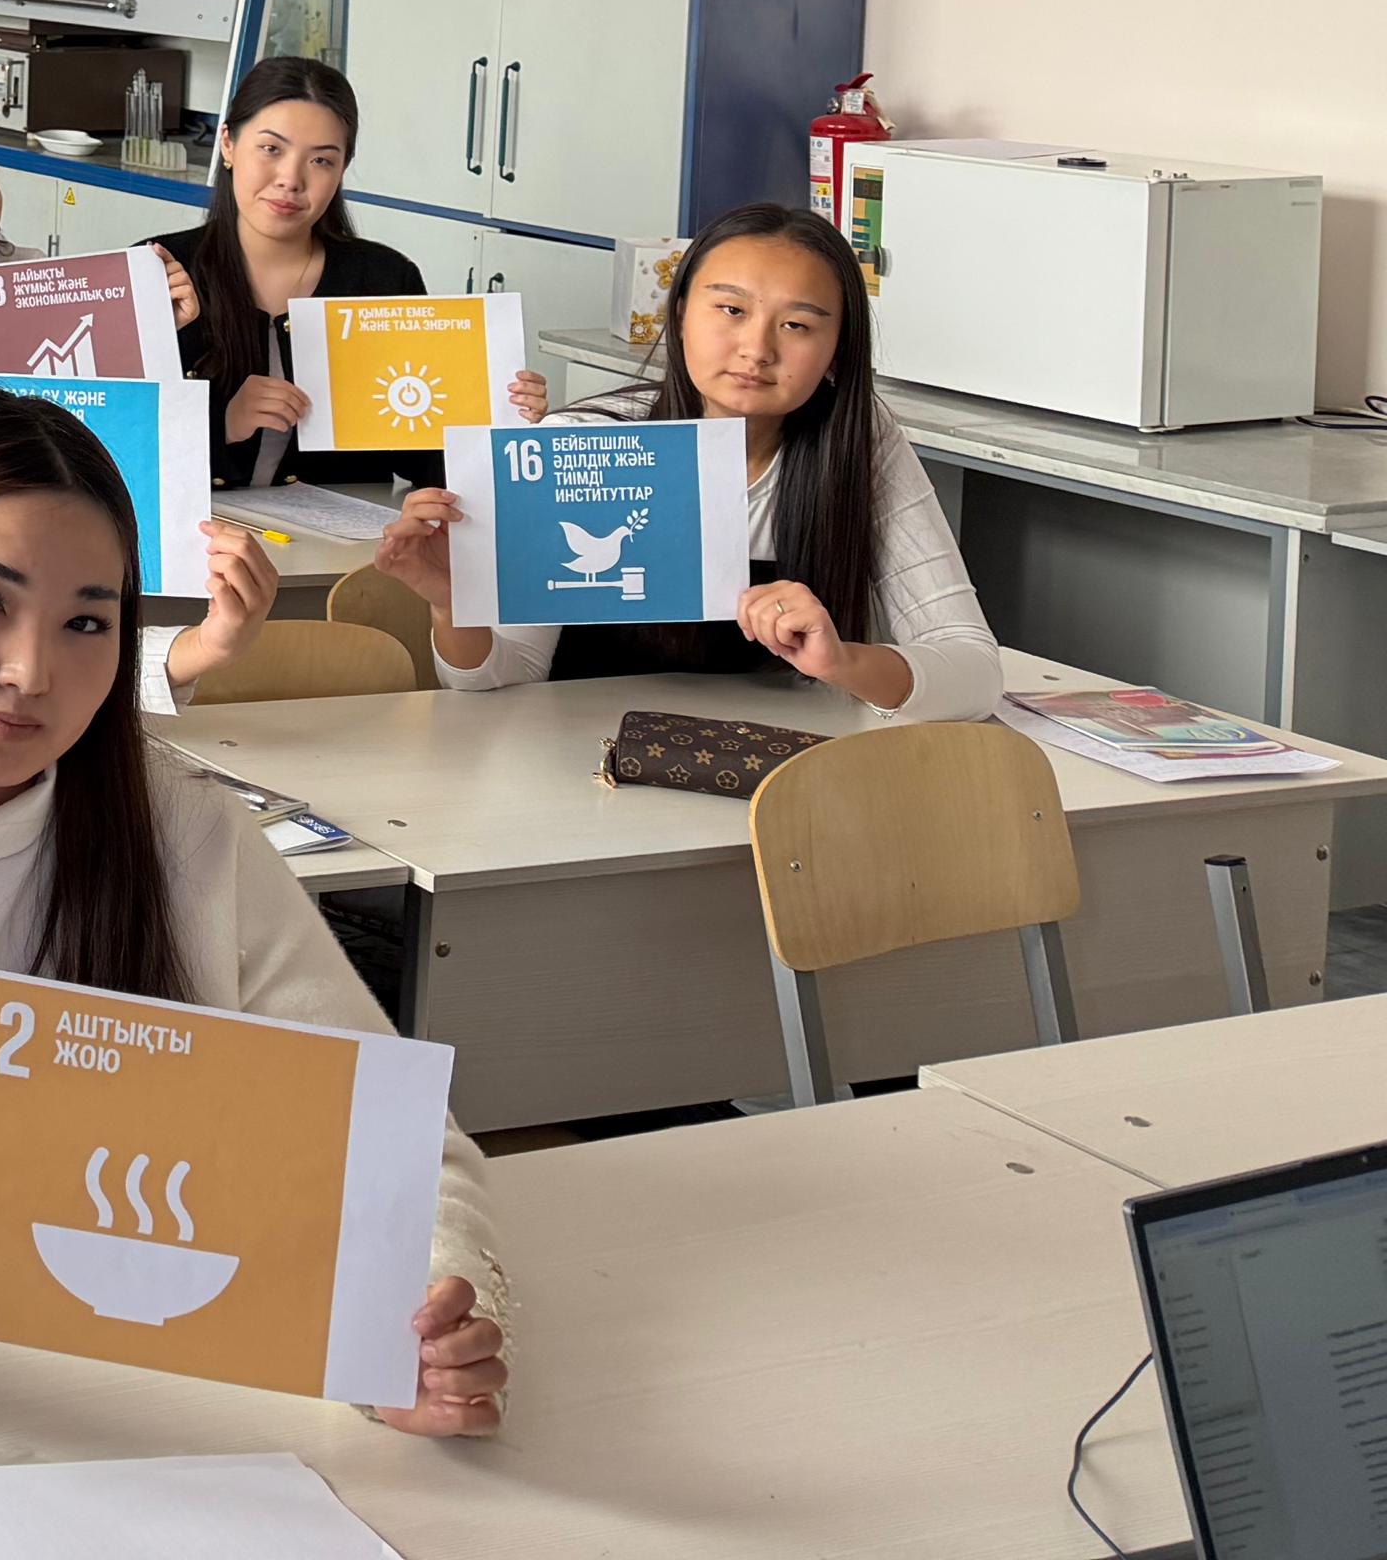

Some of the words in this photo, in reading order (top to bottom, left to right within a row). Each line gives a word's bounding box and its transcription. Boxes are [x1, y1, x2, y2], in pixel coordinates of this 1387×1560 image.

[12, 267, 65, 283] ЛАЙЫҚТЫ
[13, 282, 56, 296] ЖҰМЫС
[57, 277, 89, 291] ЖӘНЕ
[14, 290, 105, 309] ЭКОНОМИКАЛЫҚ
[105, 286, 126, 299] ӨСУ
[358, 307, 405, 320] ҚЫМБАТ
[406, 306, 435, 318] ЕМЕС
[338, 308, 353, 340] 7
[359, 320, 390, 331] ЖӘНЕ
[394, 320, 421, 331] ТАЗА
[423, 319, 471, 331] ЭНЕРГИЯ
[64, 390, 106, 406] ЖӘНЕ
[552, 435, 644, 452] БЕЙБІТШІЛІК,
[504, 439, 544, 482] 16
[553, 454, 612, 470] ӘДІЛДІК
[615, 452, 656, 467] ЖӘНЕ
[553, 471, 603, 487] ТИІМДІ
[555, 487, 653, 503] ИНСТИТУТТАР
[56, 1010, 192, 1055] АШТЫҚТЫ
[53, 1040, 121, 1074] ЖОЮ
